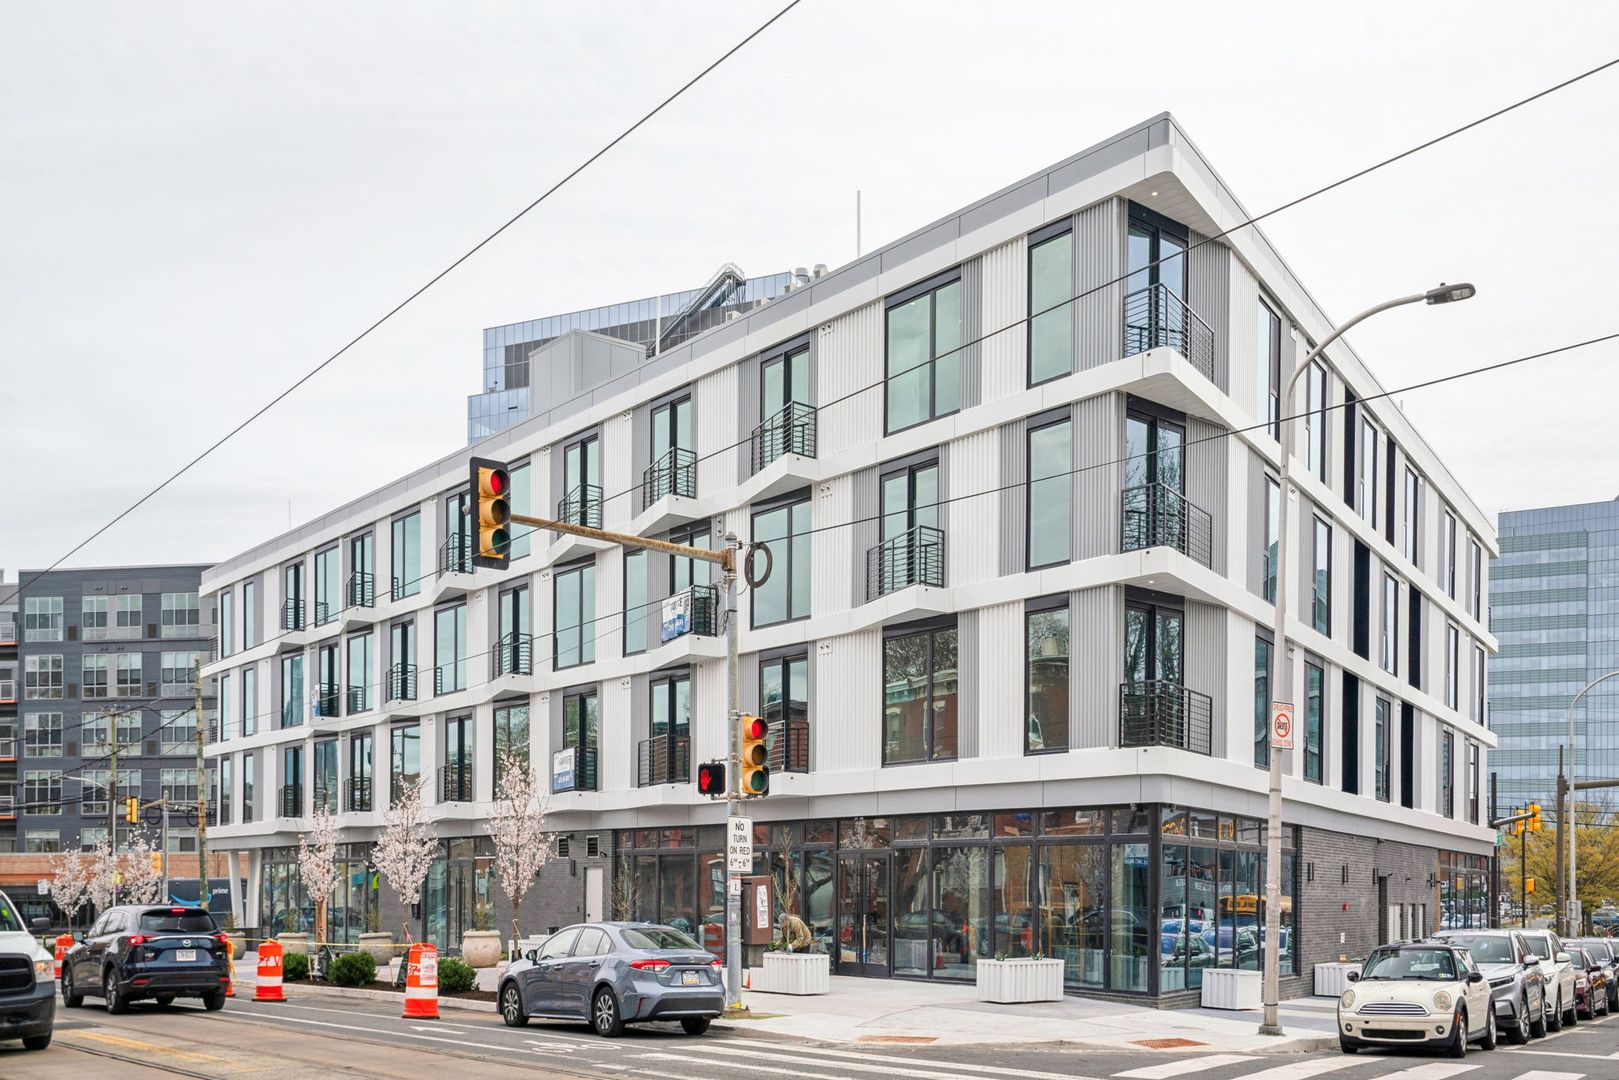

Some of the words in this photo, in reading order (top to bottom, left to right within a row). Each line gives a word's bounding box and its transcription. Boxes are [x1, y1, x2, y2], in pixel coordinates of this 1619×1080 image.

[735, 822, 745, 831] NO
[733, 834, 748, 843] TURN
[729, 845, 738, 854] ON
[739, 846, 751, 855] RED
[212, 886, 229, 895] prime
